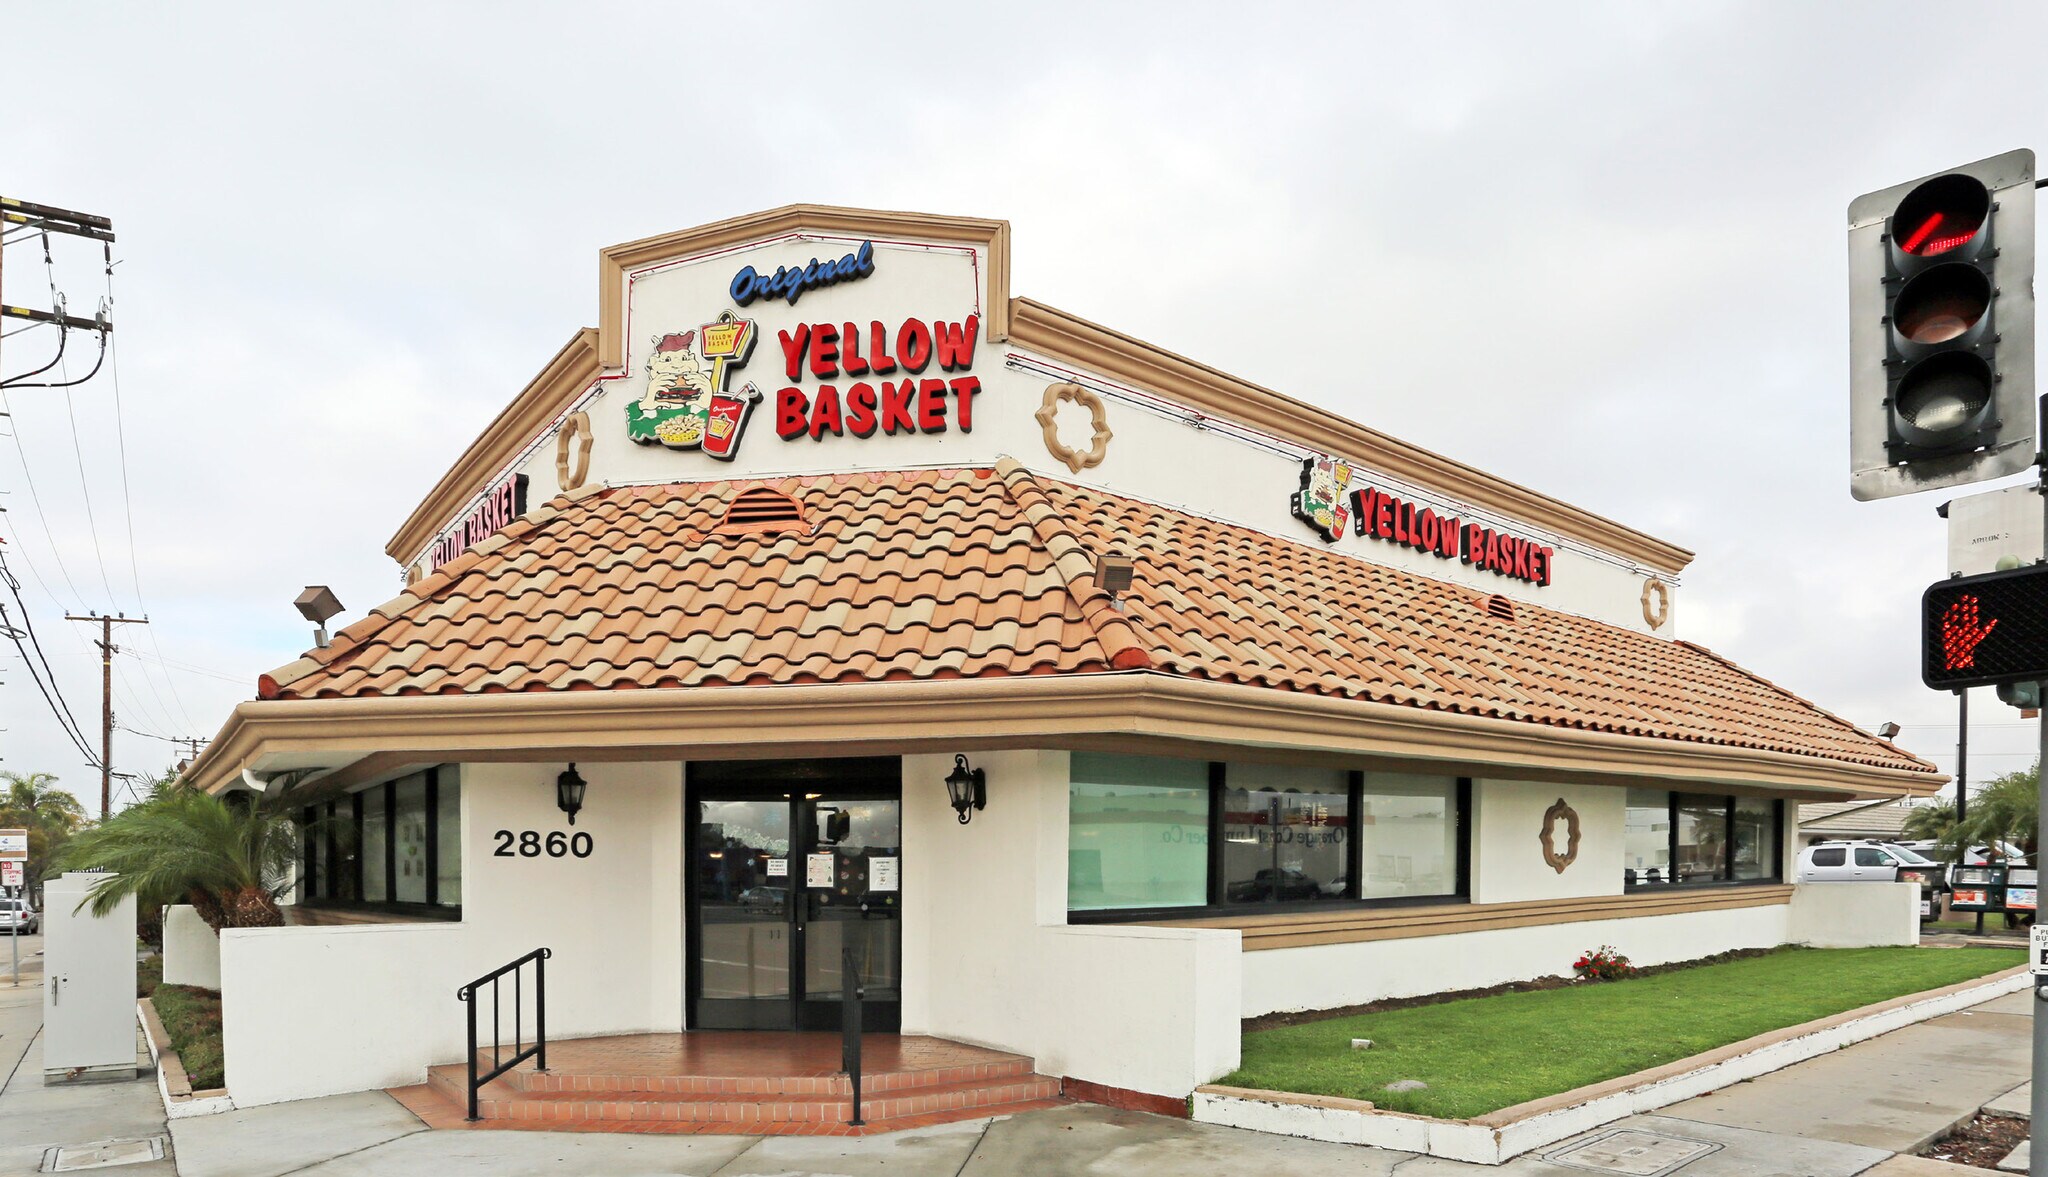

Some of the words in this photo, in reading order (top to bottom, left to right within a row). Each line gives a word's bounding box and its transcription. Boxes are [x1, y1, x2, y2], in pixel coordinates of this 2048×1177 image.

[731, 240, 875, 304] Original
[778, 315, 979, 381] YELLOW
[776, 376, 981, 441] BASKET
[469, 473, 518, 545] BASKET
[1357, 487, 1460, 559] YELLOW
[1468, 523, 1553, 586] BASKET
[493, 830, 594, 858] 2860
